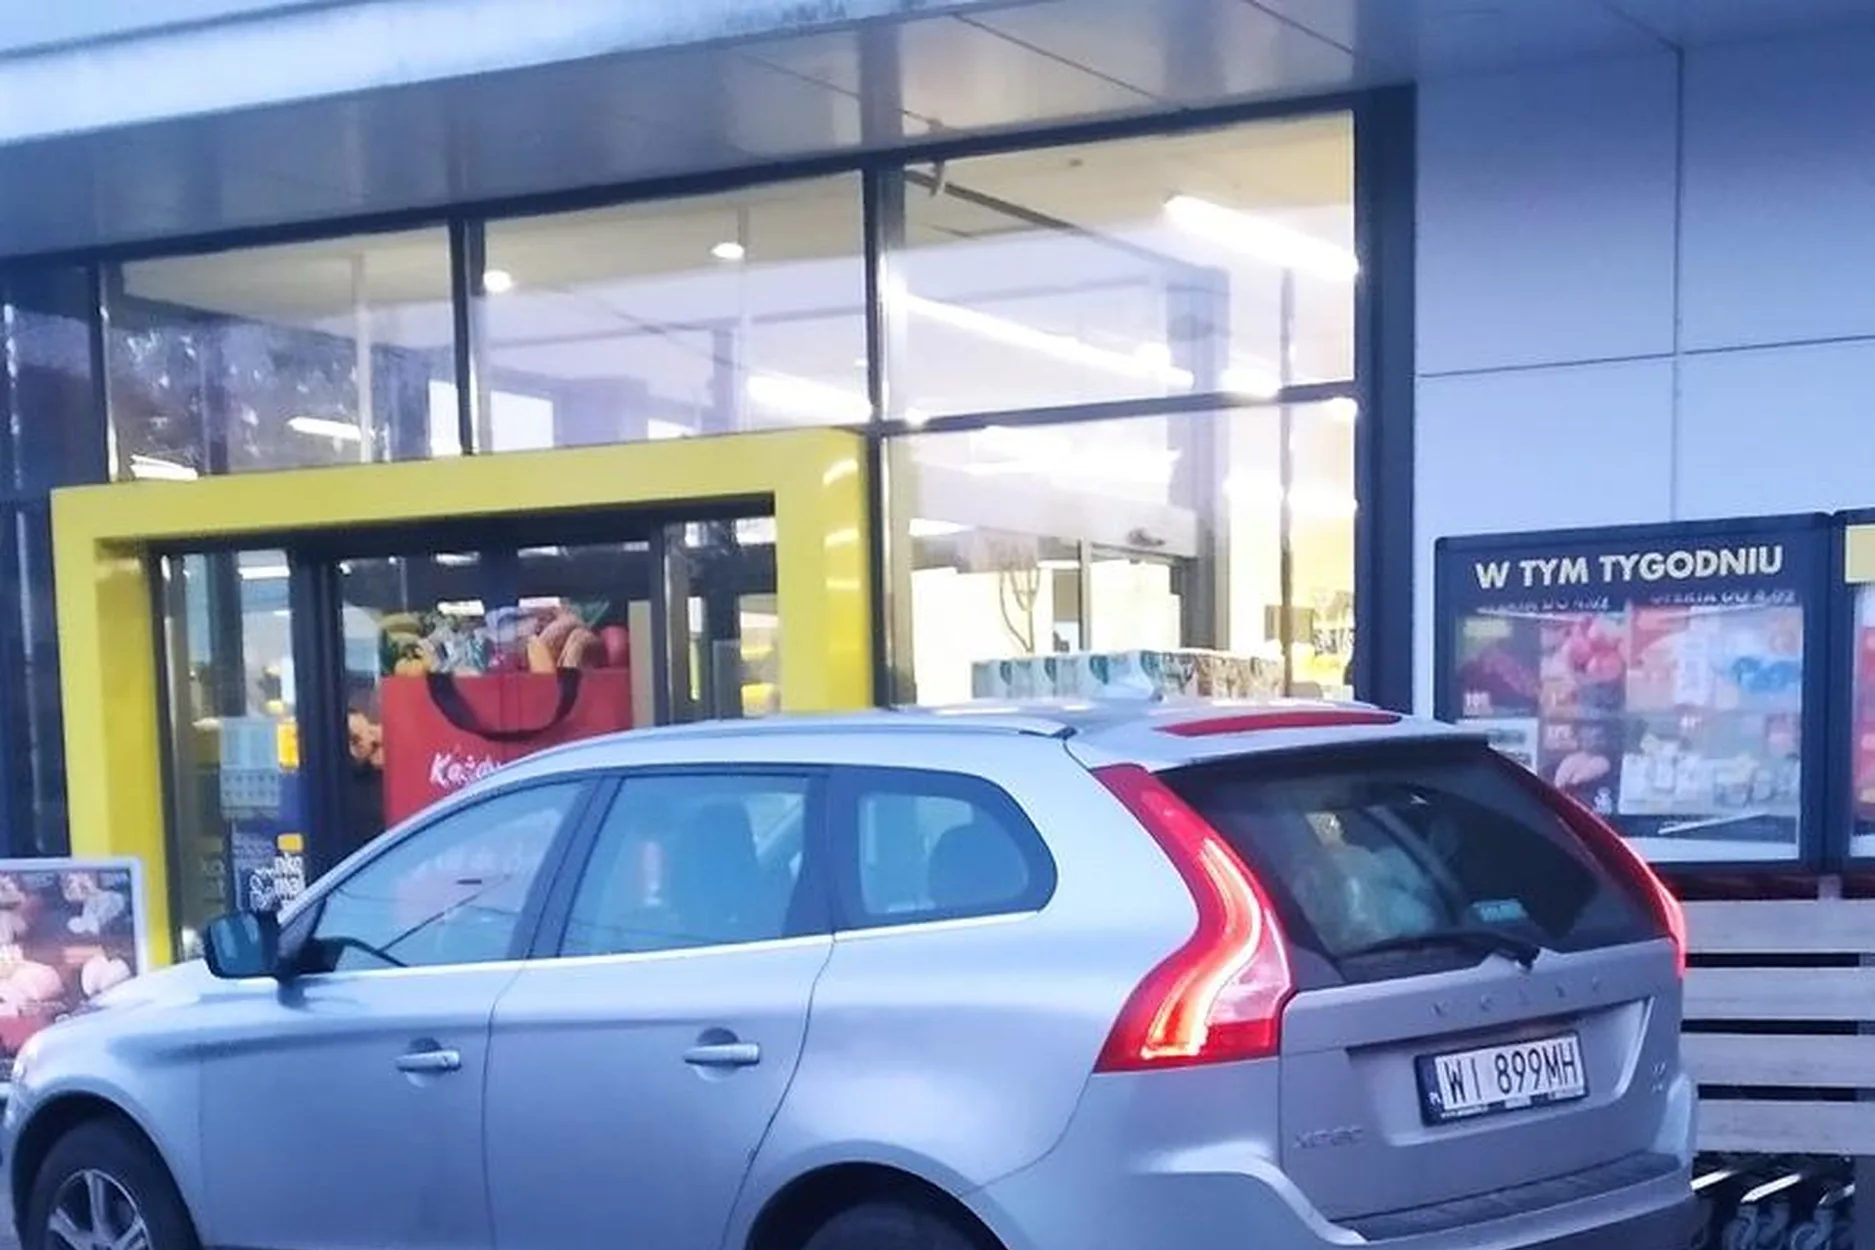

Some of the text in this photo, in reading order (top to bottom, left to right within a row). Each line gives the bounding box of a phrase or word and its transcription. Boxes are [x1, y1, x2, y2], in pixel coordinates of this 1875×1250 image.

[1475, 545, 1783, 589] W TYM TYGODNIU
[1443, 1041, 1578, 1104] WI 899MH
